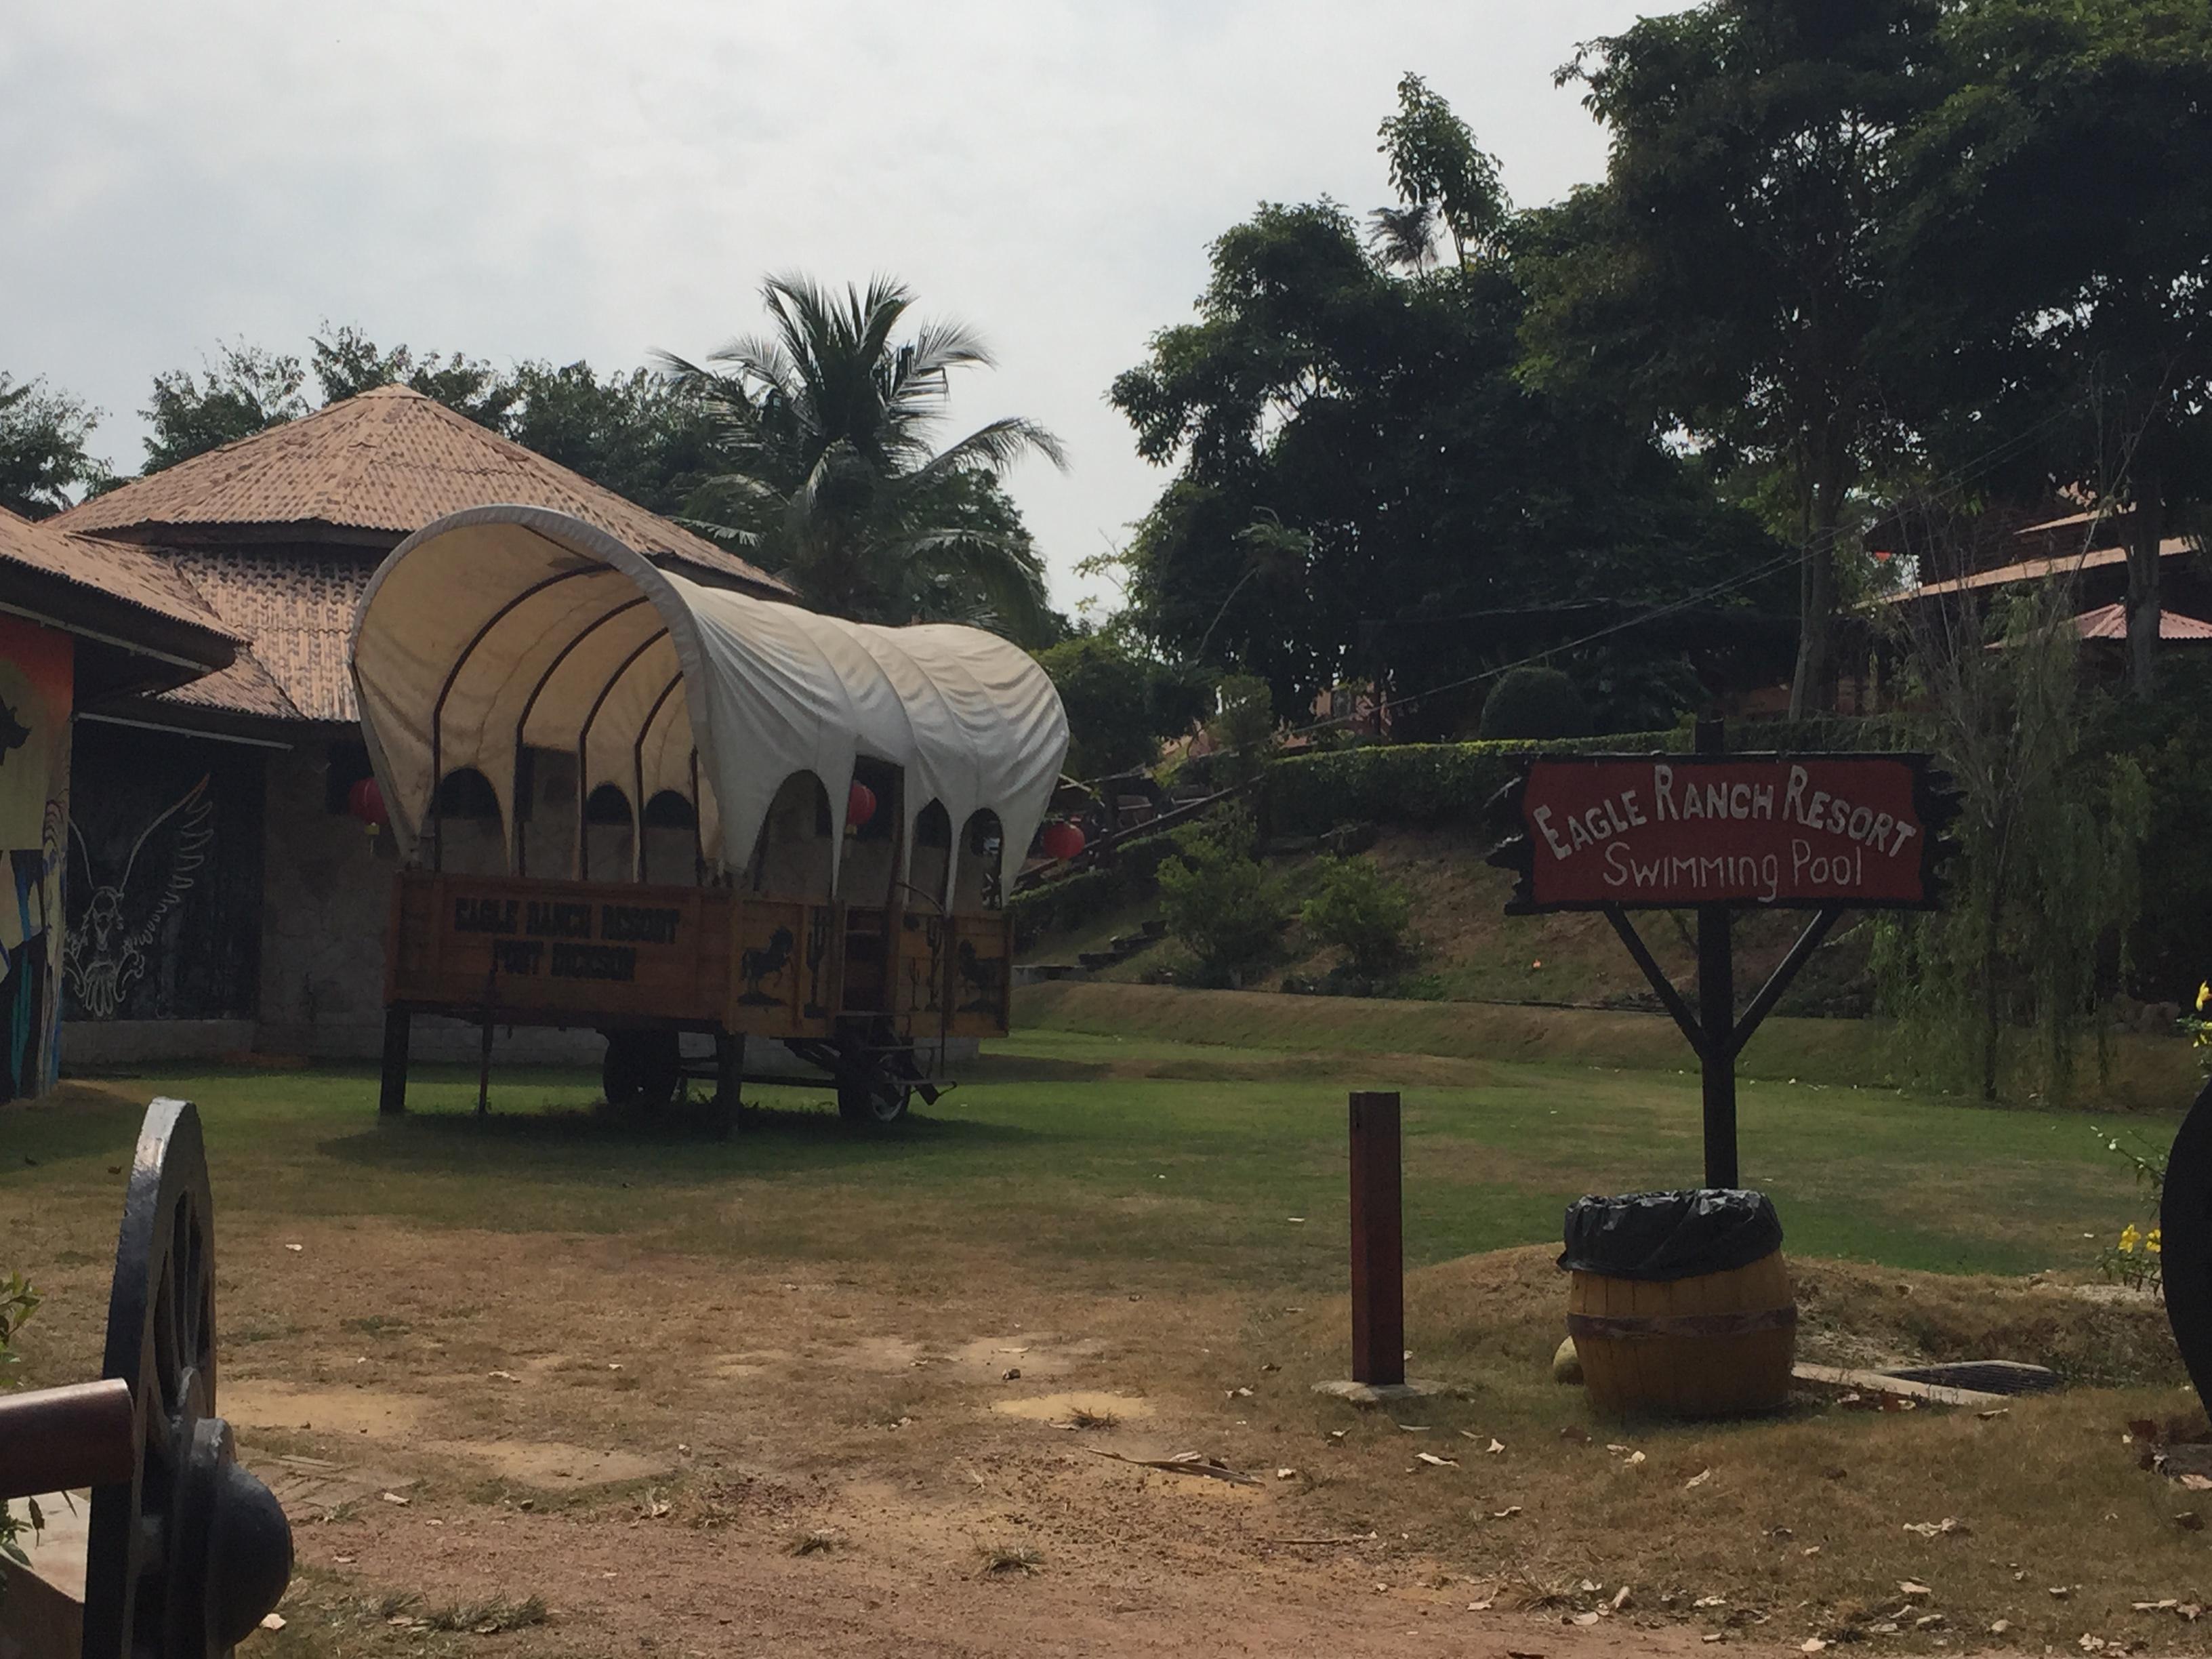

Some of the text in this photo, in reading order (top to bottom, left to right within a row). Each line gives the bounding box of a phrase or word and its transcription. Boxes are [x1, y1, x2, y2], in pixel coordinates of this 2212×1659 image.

[1534, 765, 1917, 859] EAGLE RANCH RESORT
[1793, 840, 1862, 886] Pool
